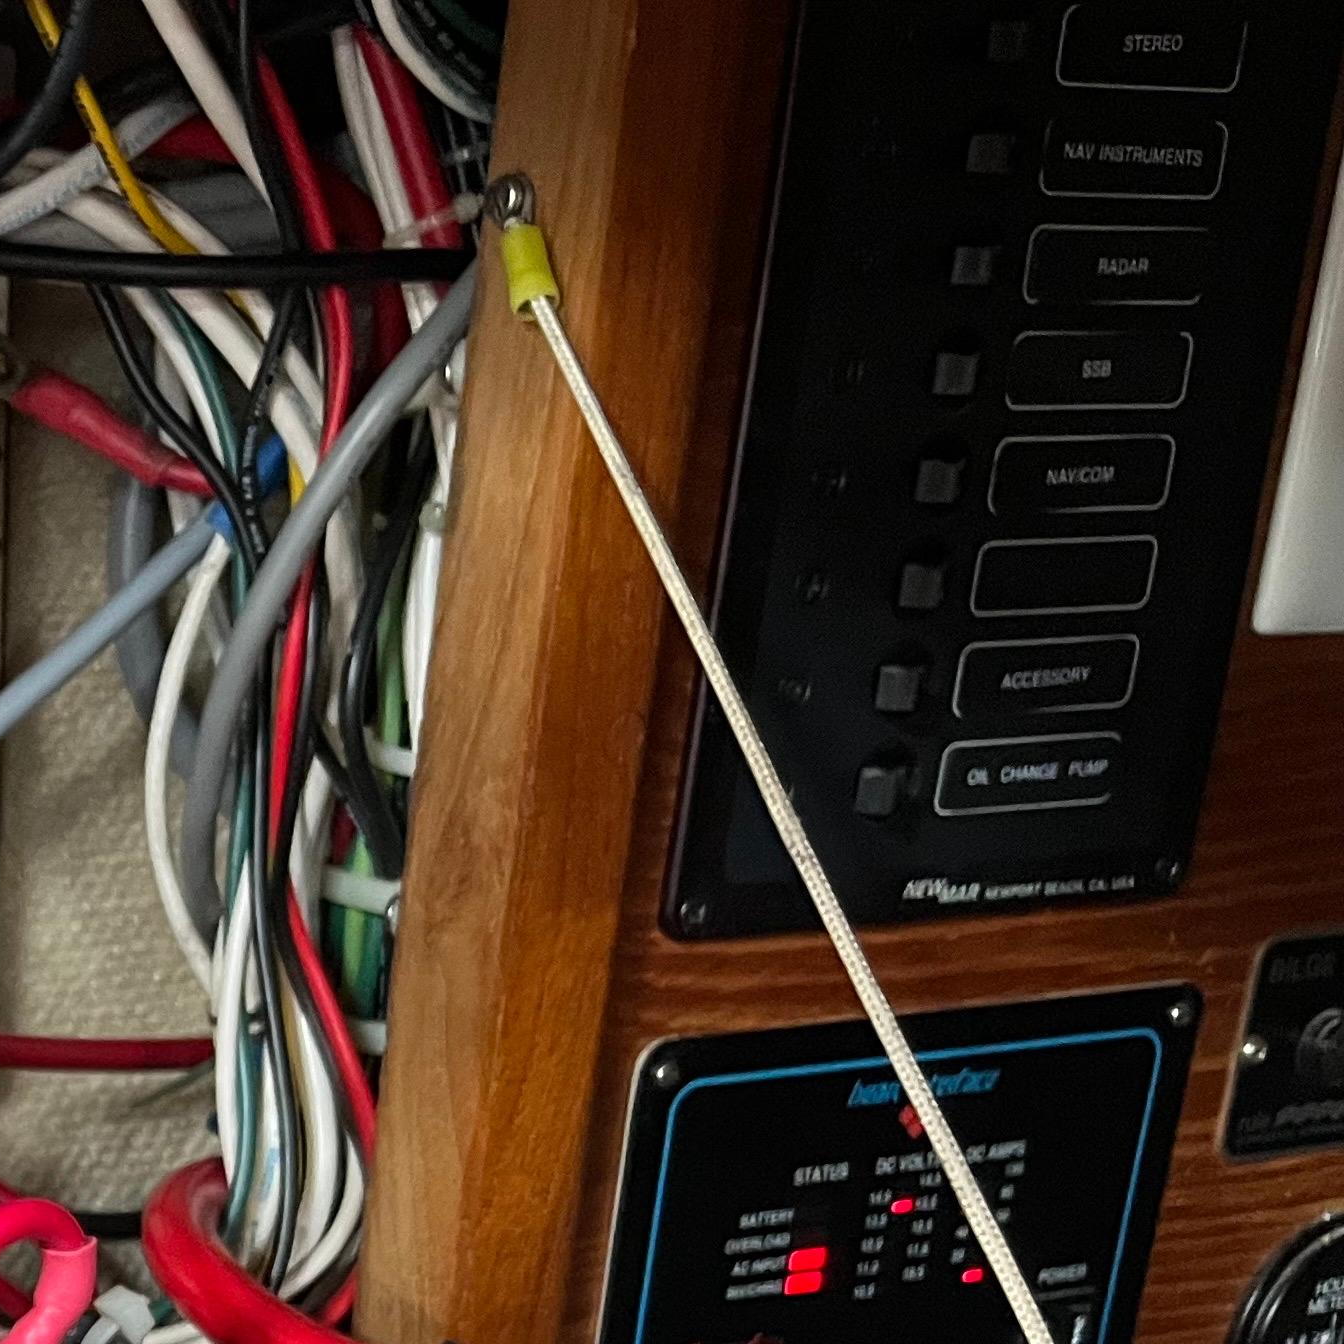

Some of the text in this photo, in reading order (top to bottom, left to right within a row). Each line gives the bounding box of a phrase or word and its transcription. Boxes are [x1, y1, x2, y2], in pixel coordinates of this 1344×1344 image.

[1122, 34, 1184, 53] STEREO
[1063, 141, 1204, 168] NAV INSTRUMENTS
[1097, 256, 1150, 277] RADAR
[1081, 359, 1112, 379] SSB
[1000, 664, 1091, 690] ACCESSORY
[966, 758, 1110, 786] OIL CHANGE PUMP
[793, 1161, 850, 1186] STATUS
[899, 1150, 942, 1173] VOLT
[738, 1207, 795, 1231] BATTERY
